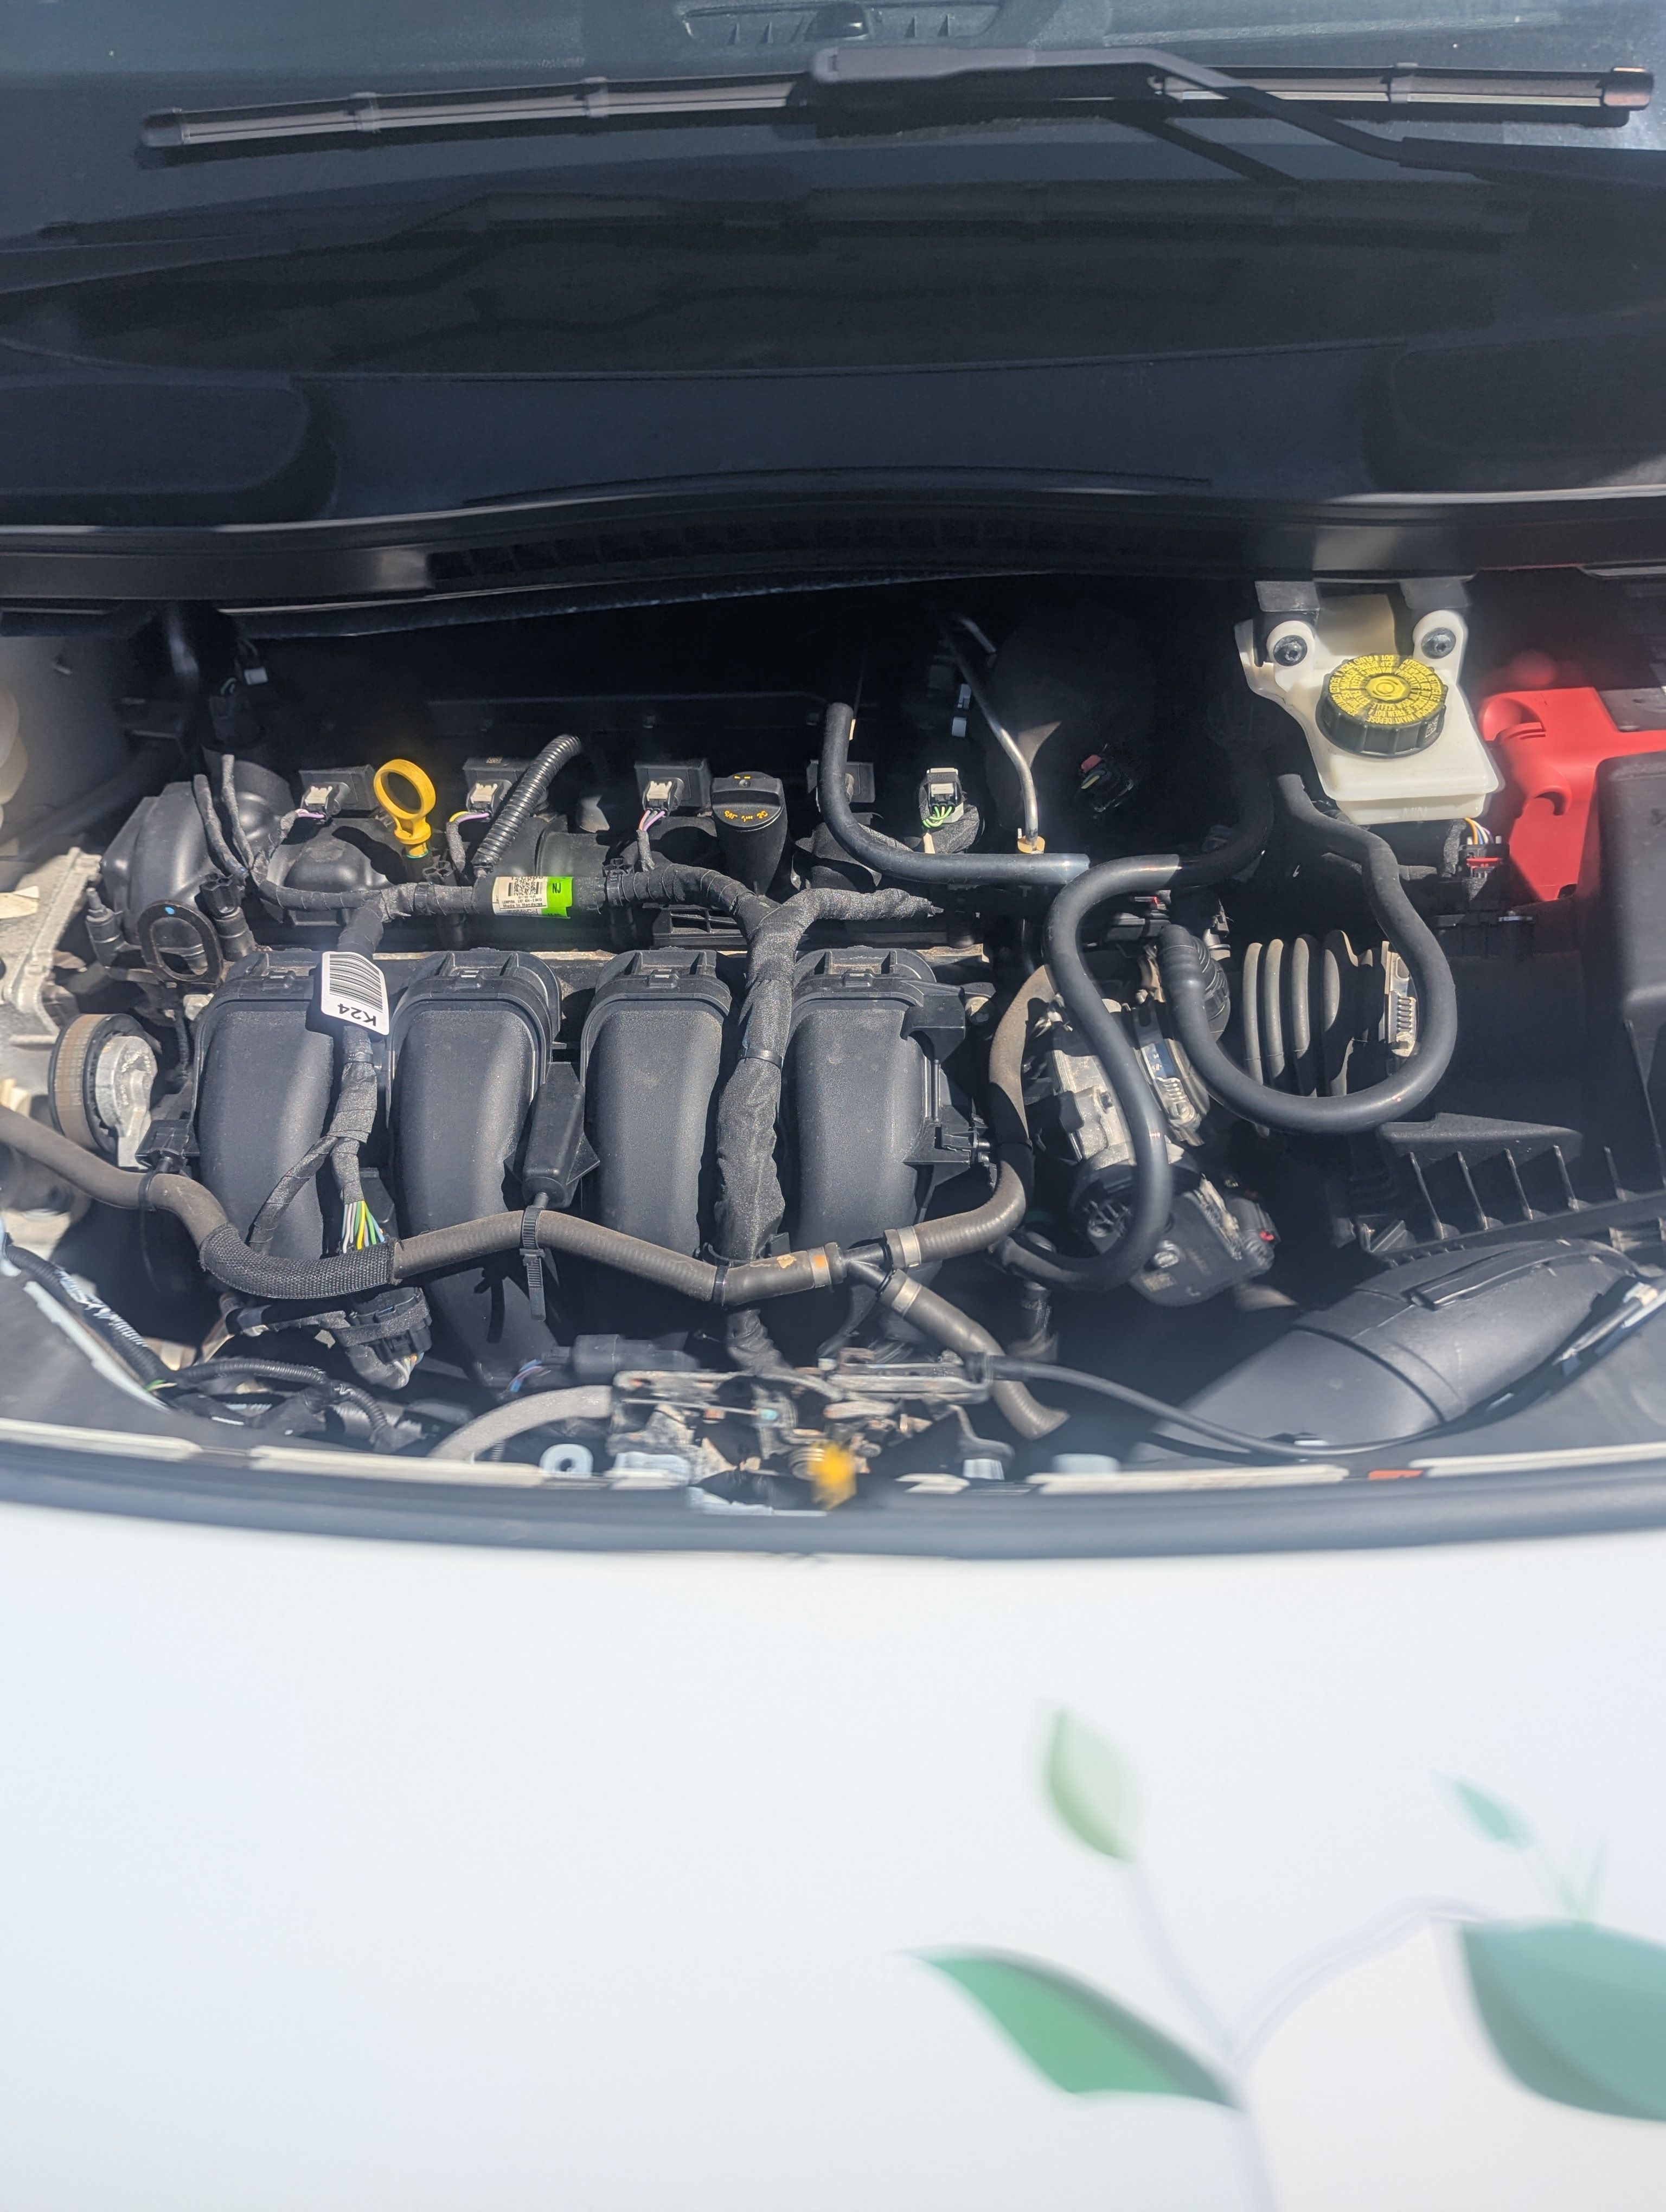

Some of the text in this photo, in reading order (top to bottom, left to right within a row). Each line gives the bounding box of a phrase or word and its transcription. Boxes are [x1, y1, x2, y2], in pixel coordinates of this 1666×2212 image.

[1353, 655, 1373, 665] FLUID
[1337, 662, 1355, 673] FROM
[1354, 661, 1379, 672] BEFORE
[1402, 658, 1433, 676] ATTENTION
[1329, 677, 1341, 693] SEALED
[1331, 694, 1358, 717] CONTAINER
[1367, 716, 1392, 724] DEPOSE
[1395, 714, 1415, 724] AVANT
[552, 883, 561, 893] NJ
[337, 1003, 376, 1027] K24
